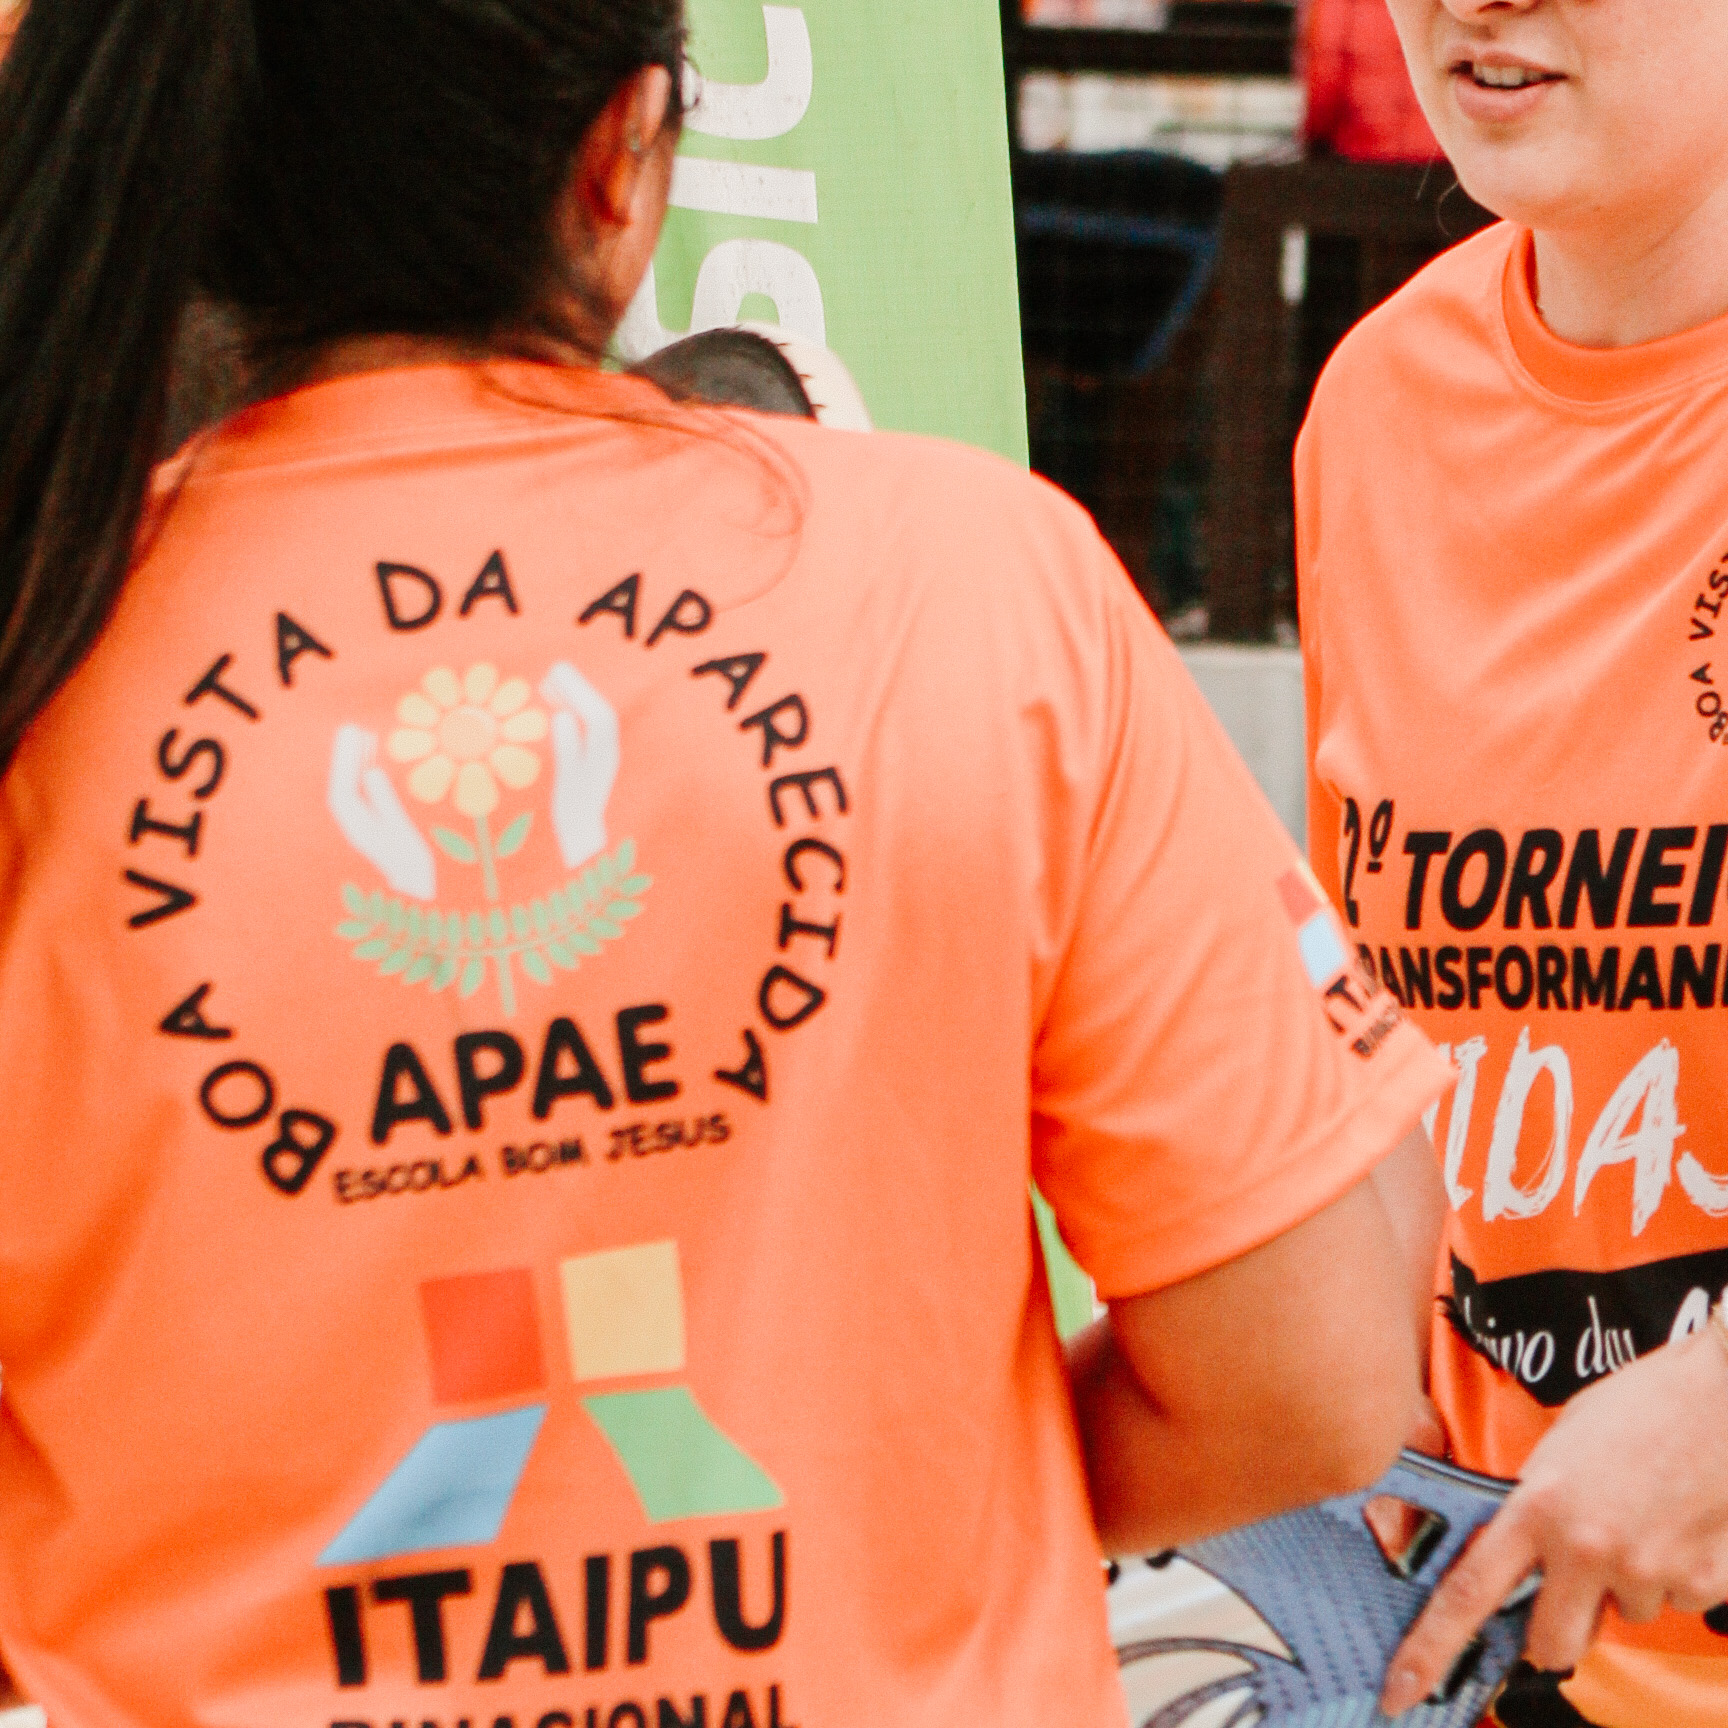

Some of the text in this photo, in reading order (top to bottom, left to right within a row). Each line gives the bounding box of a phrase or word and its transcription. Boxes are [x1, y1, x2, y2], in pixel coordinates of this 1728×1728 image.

[122, 548, 851, 1196] BOA VISTA DA APARECIDA
[370, 1003, 681, 1145] APAE
[334, 1112, 731, 1204] ESCOLA BOM JESUS
[322, 1528, 789, 1688] ITAIPU
